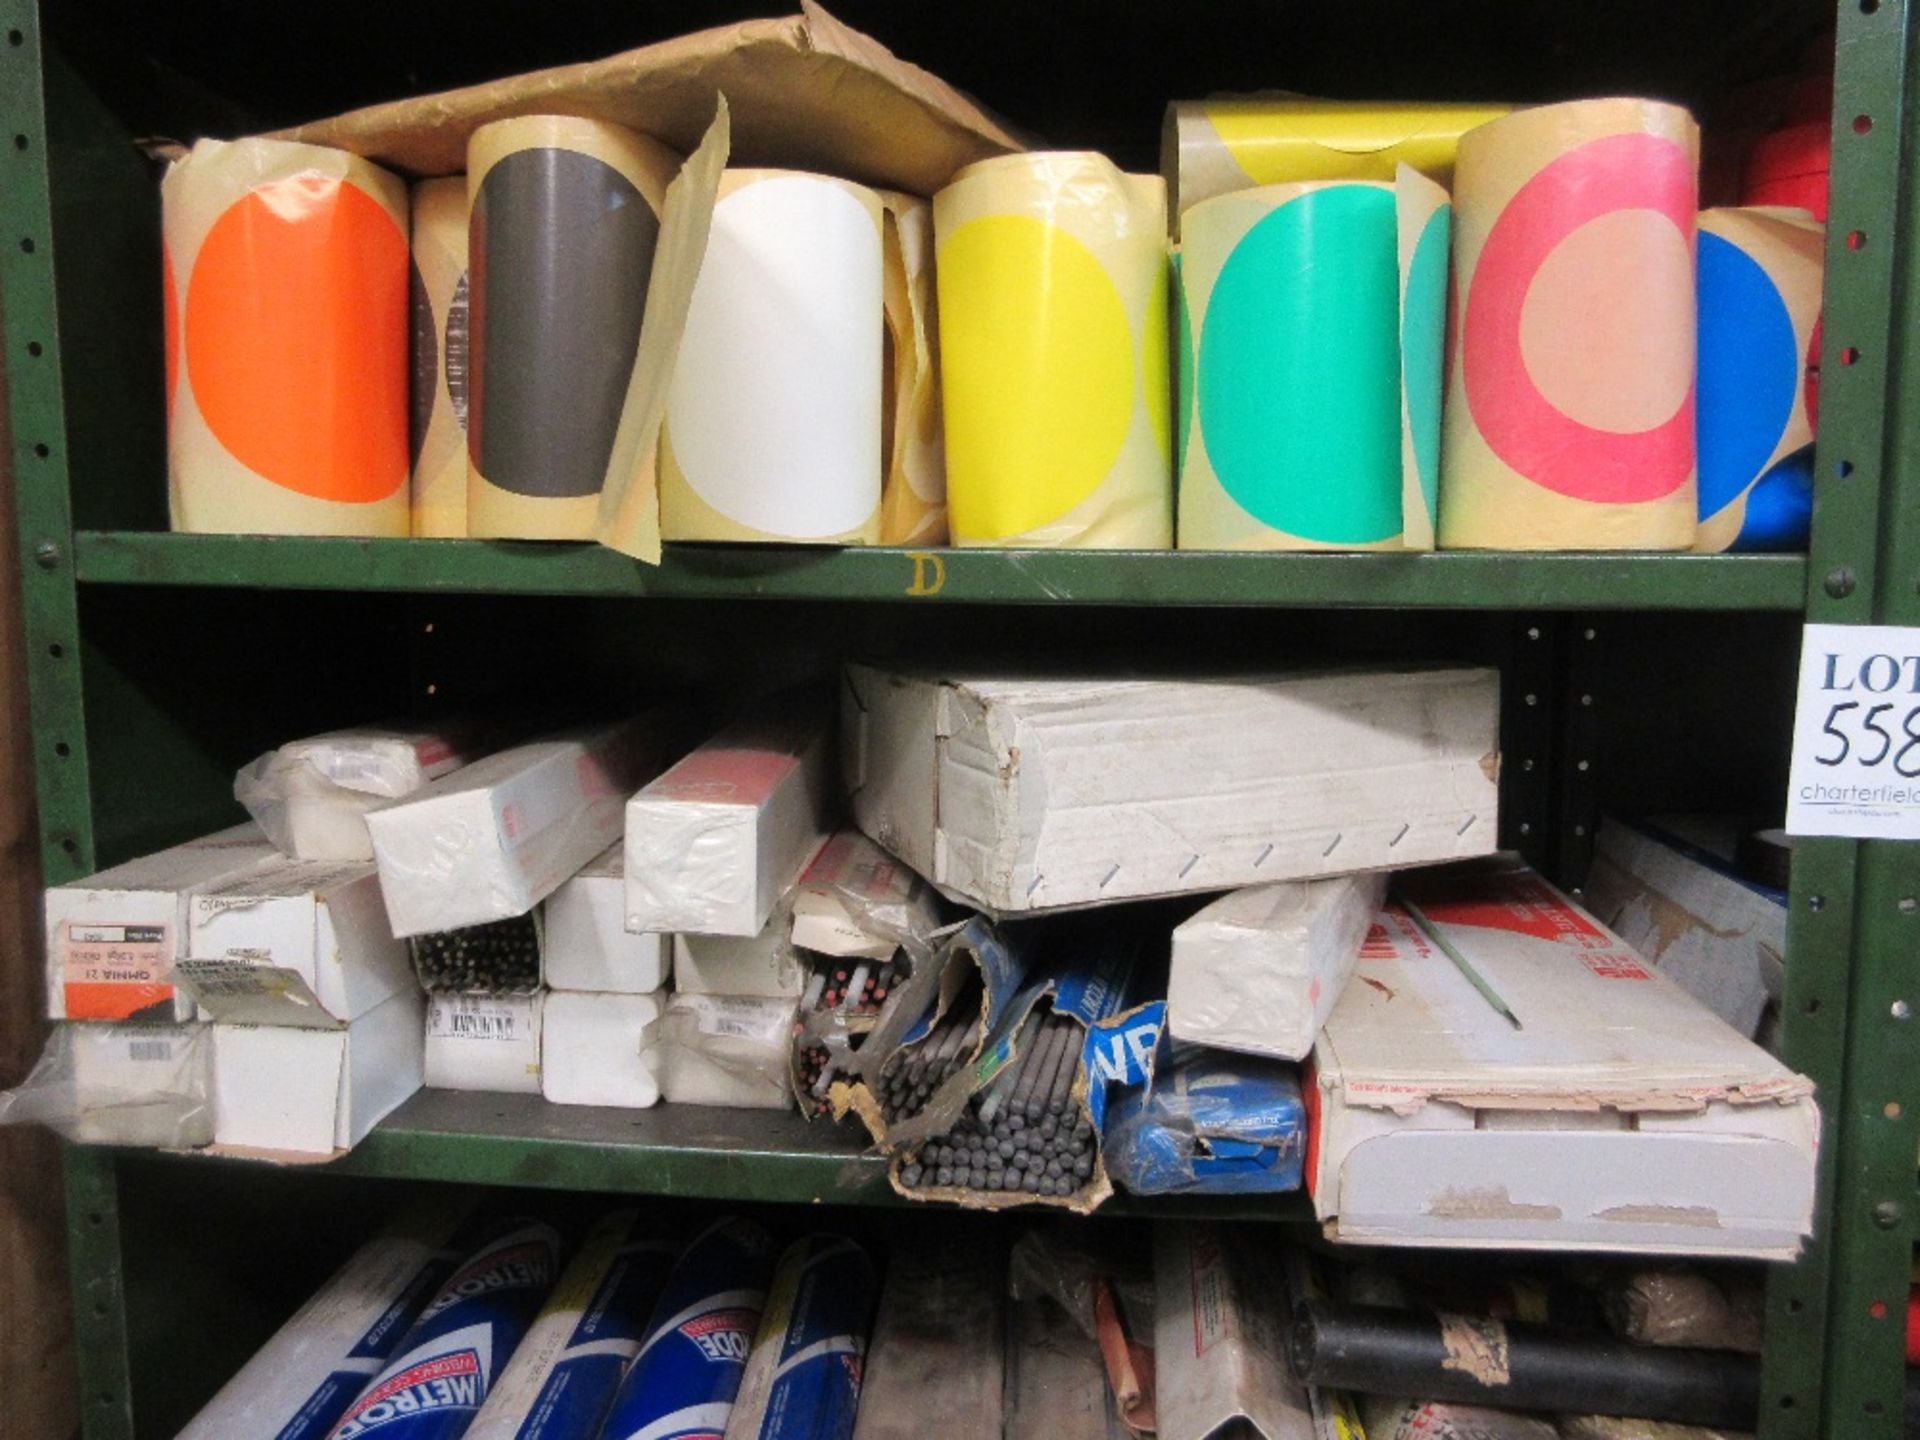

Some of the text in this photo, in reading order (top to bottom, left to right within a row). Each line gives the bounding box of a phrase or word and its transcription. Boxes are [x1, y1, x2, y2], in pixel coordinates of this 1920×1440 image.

[904, 551, 944, 596] D
[1815, 701, 1920, 777] 558
[86, 969, 151, 981] OMNIA 21
